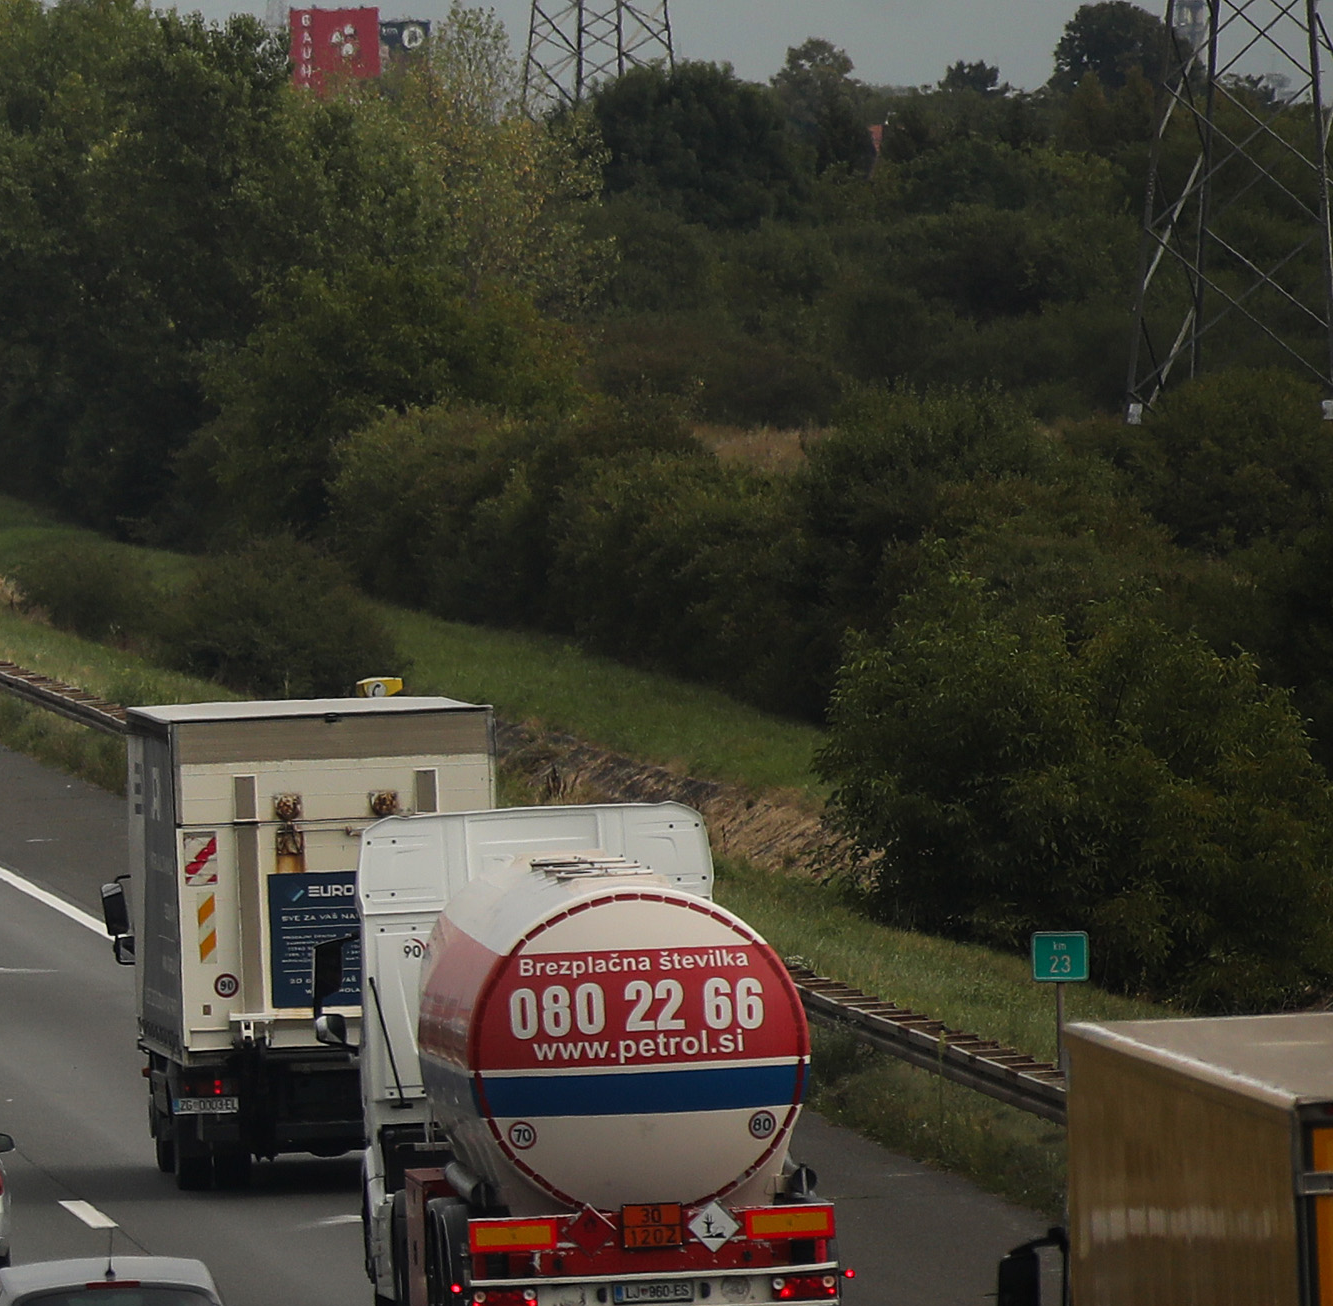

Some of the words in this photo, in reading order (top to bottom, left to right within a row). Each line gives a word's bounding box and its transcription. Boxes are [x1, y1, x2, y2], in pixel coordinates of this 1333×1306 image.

[404, 945, 422, 959] 90
[1052, 941, 1067, 951] km
[519, 953, 652, 979] Brezplačna
[659, 949, 749, 970] številka
[1049, 955, 1071, 973] 23
[220, 980, 234, 991] 90
[510, 982, 606, 1040] 080
[624, 978, 686, 1032] 22
[703, 976, 764, 1030] 66
[533, 1029, 745, 1063] www.petrol.si
[752, 1116, 773, 1132] 80
[513, 1128, 533, 1143] 70
[641, 1208, 663, 1223] 30
[631, 1227, 677, 1246] 1202
[626, 1285, 641, 1300] LJ
